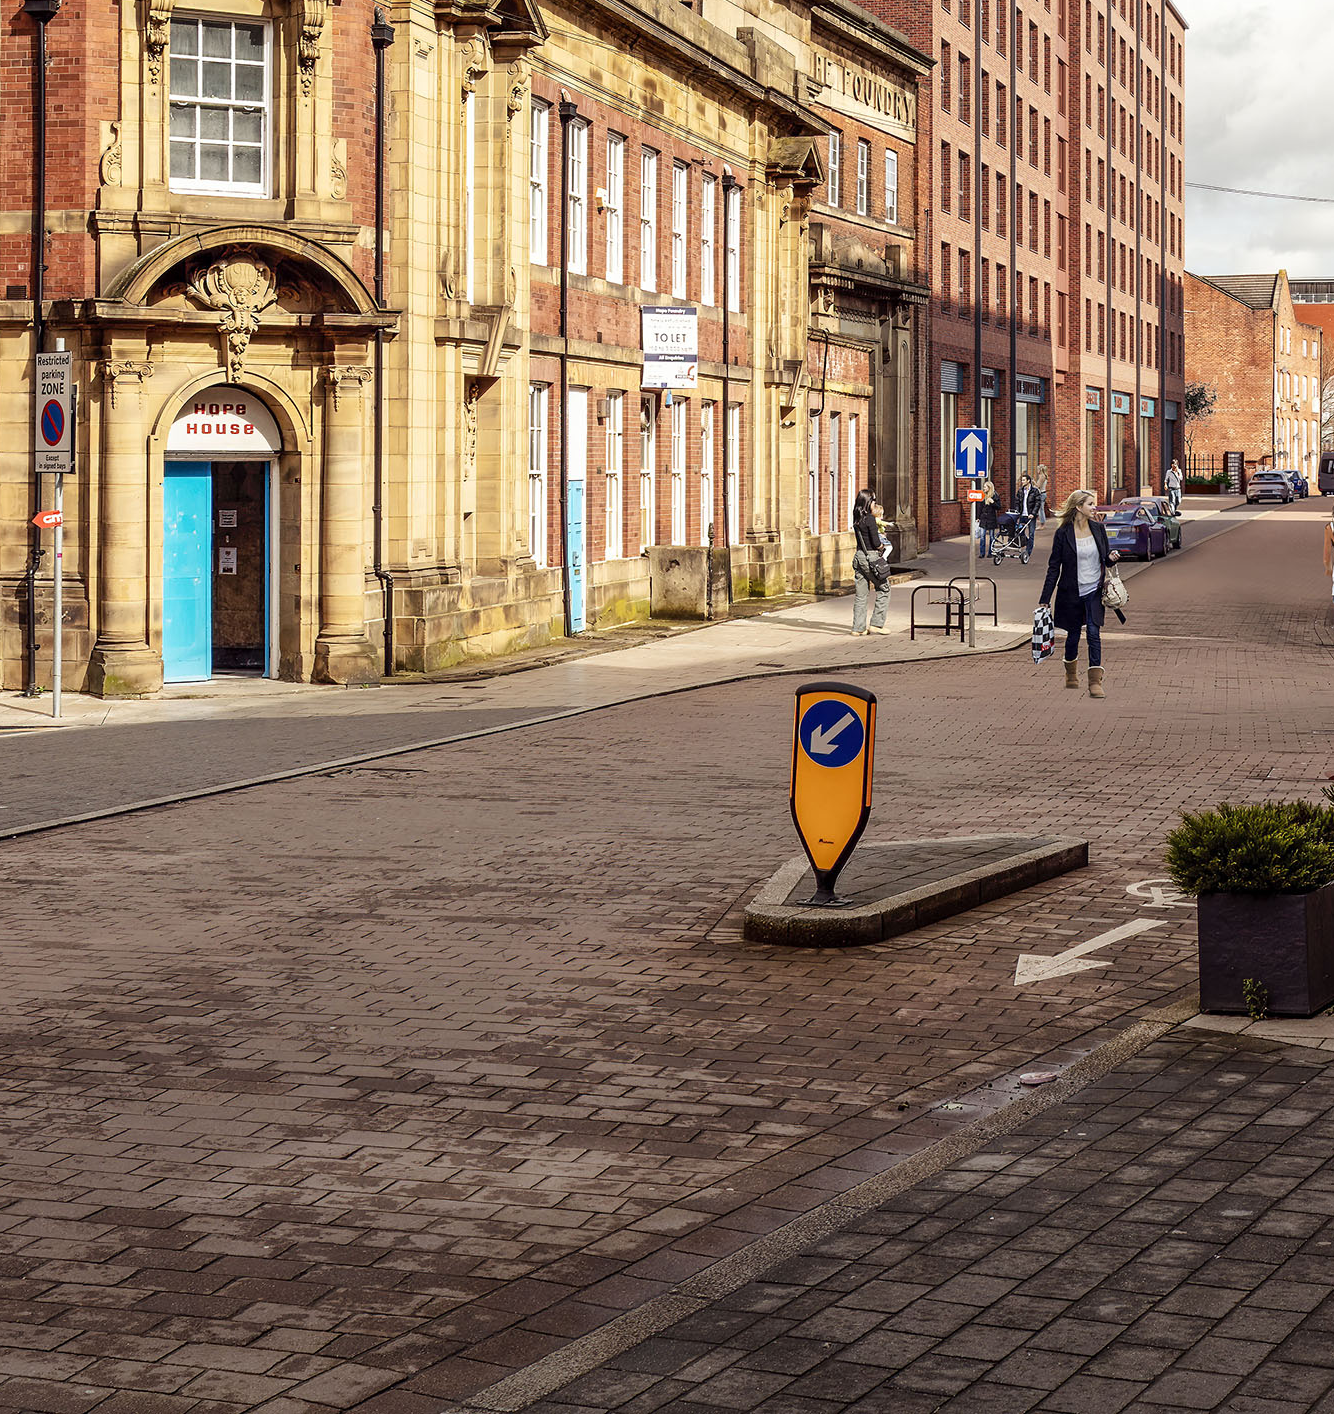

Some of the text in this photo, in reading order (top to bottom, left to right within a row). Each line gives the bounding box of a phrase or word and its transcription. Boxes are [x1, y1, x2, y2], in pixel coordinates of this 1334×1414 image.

[654, 333, 687, 343] TO LET
[37, 355, 70, 366] Restricted
[41, 369, 65, 381] parking
[41, 382, 64, 395] ZONE
[194, 403, 246, 415] HOPE
[186, 423, 255, 435] HOUSE
[45, 454, 60, 462] Except
[43, 462, 56, 471] signed
